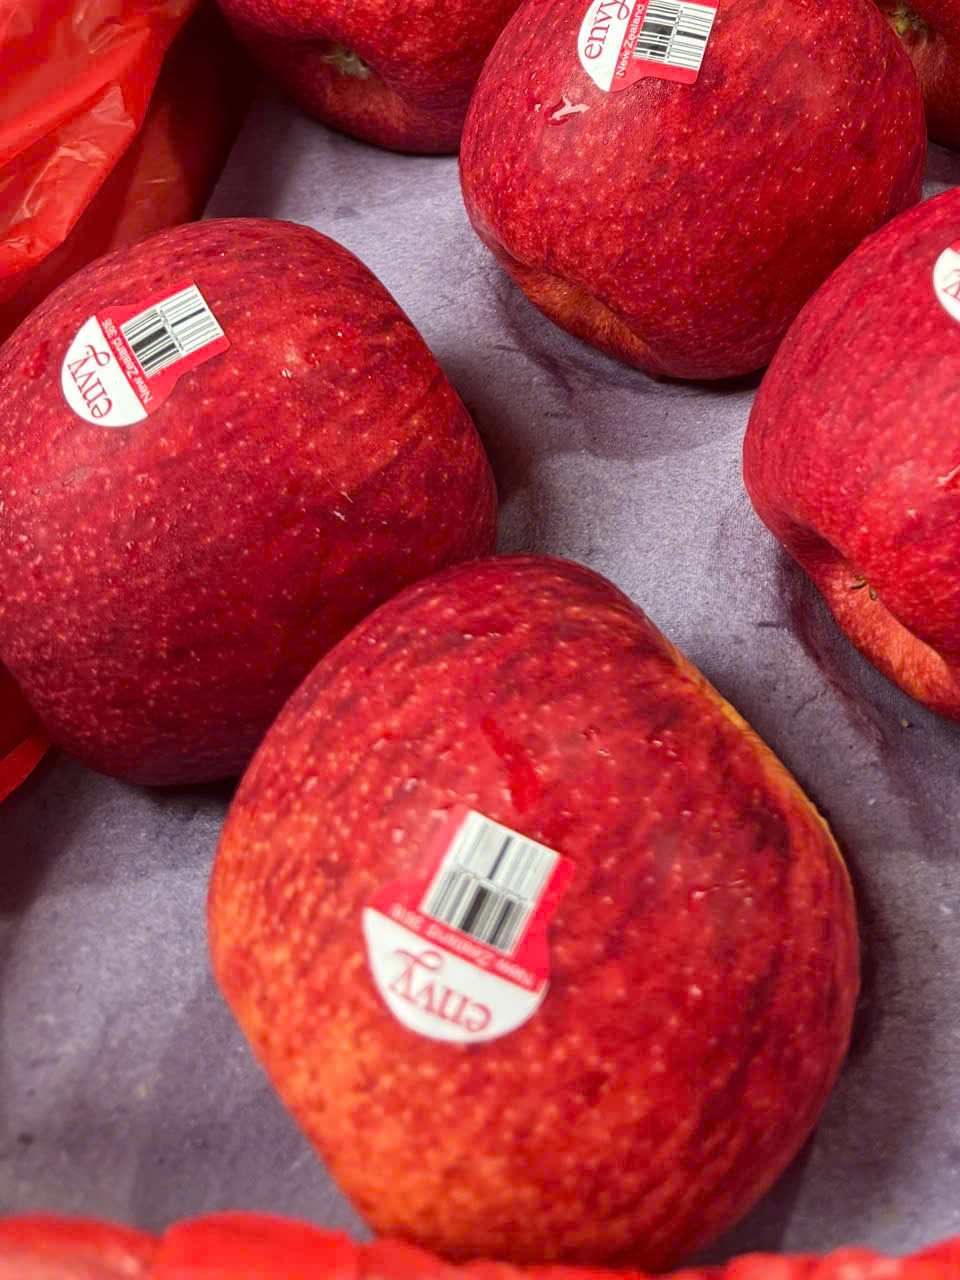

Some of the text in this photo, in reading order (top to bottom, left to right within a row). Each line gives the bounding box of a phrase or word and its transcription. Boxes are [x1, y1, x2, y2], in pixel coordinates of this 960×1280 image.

[615, 48, 631, 77] New
[623, 3, 645, 48] Zealand
[67, 344, 112, 418] envy
[113, 338, 139, 382] Zealand
[135, 380, 153, 404] New
[390, 947, 493, 1033] envy
